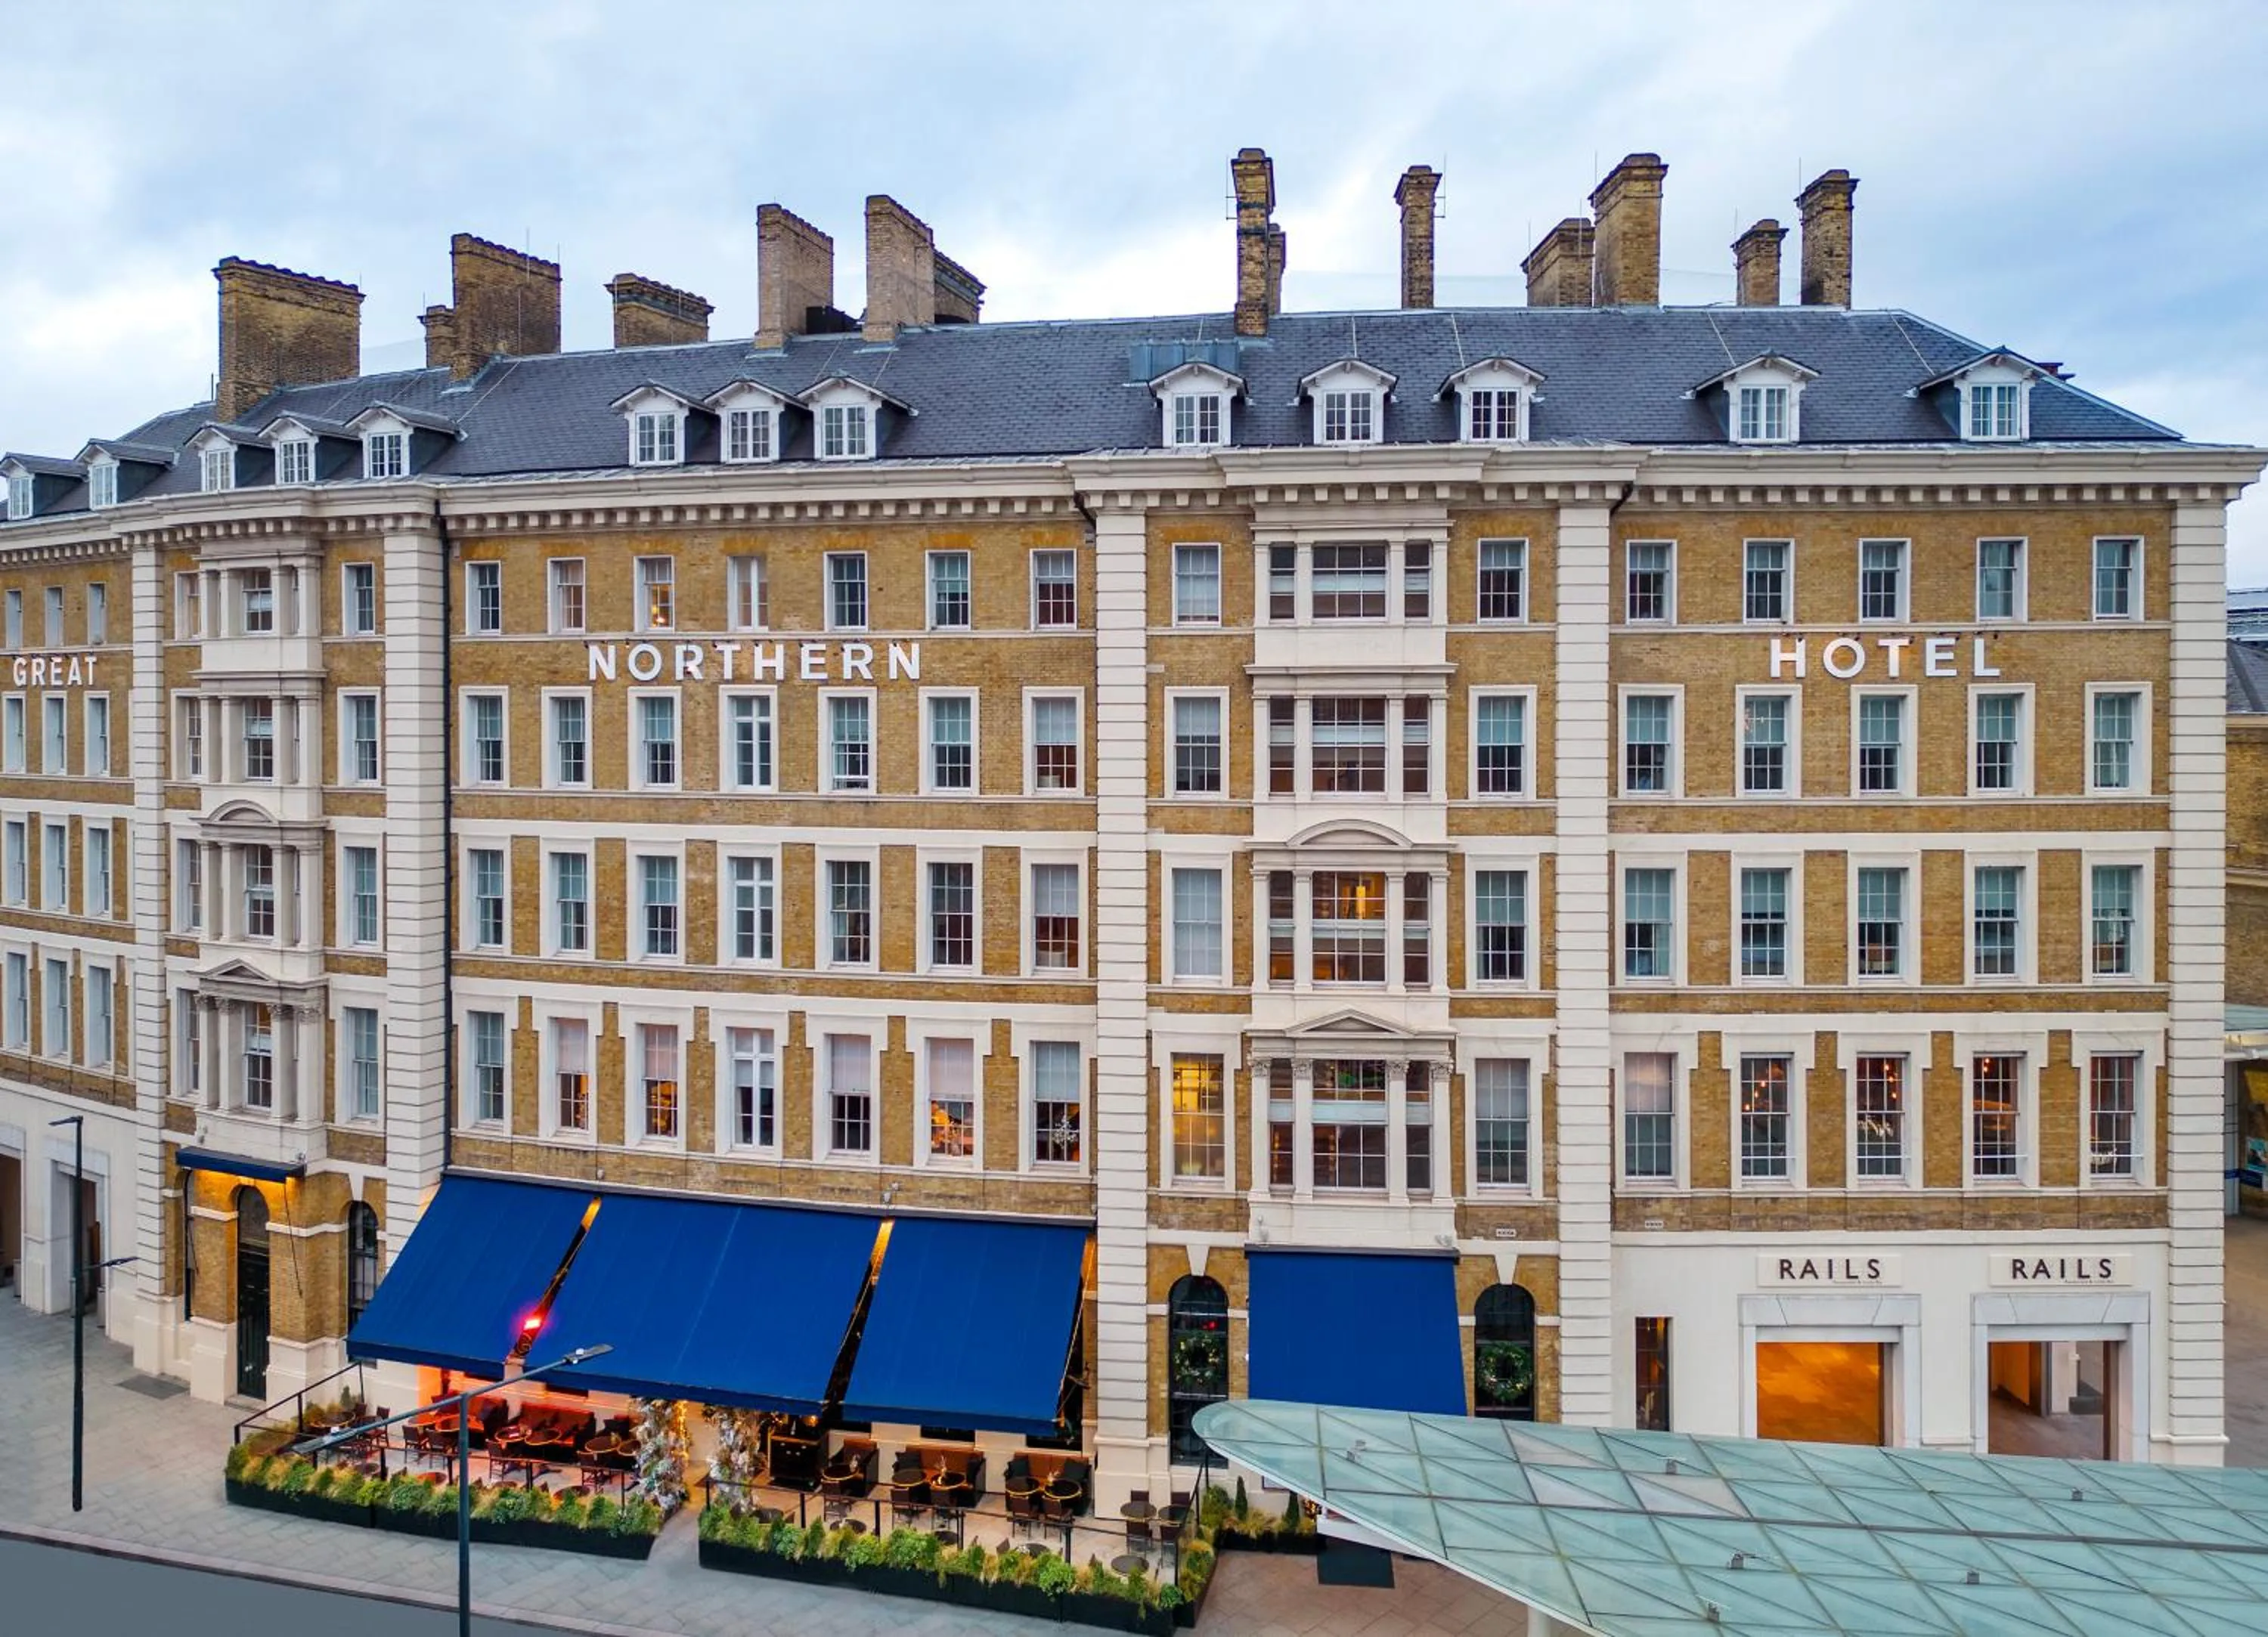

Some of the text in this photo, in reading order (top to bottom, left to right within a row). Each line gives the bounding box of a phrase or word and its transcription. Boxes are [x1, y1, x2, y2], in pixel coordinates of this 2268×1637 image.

[13, 656, 97, 687] GREAT
[588, 642, 919, 680] NORTHERN
[1770, 638, 2000, 678] HOTEL
[1780, 1258, 1880, 1280] RAILS
[2012, 1258, 2112, 1280] RAILS
